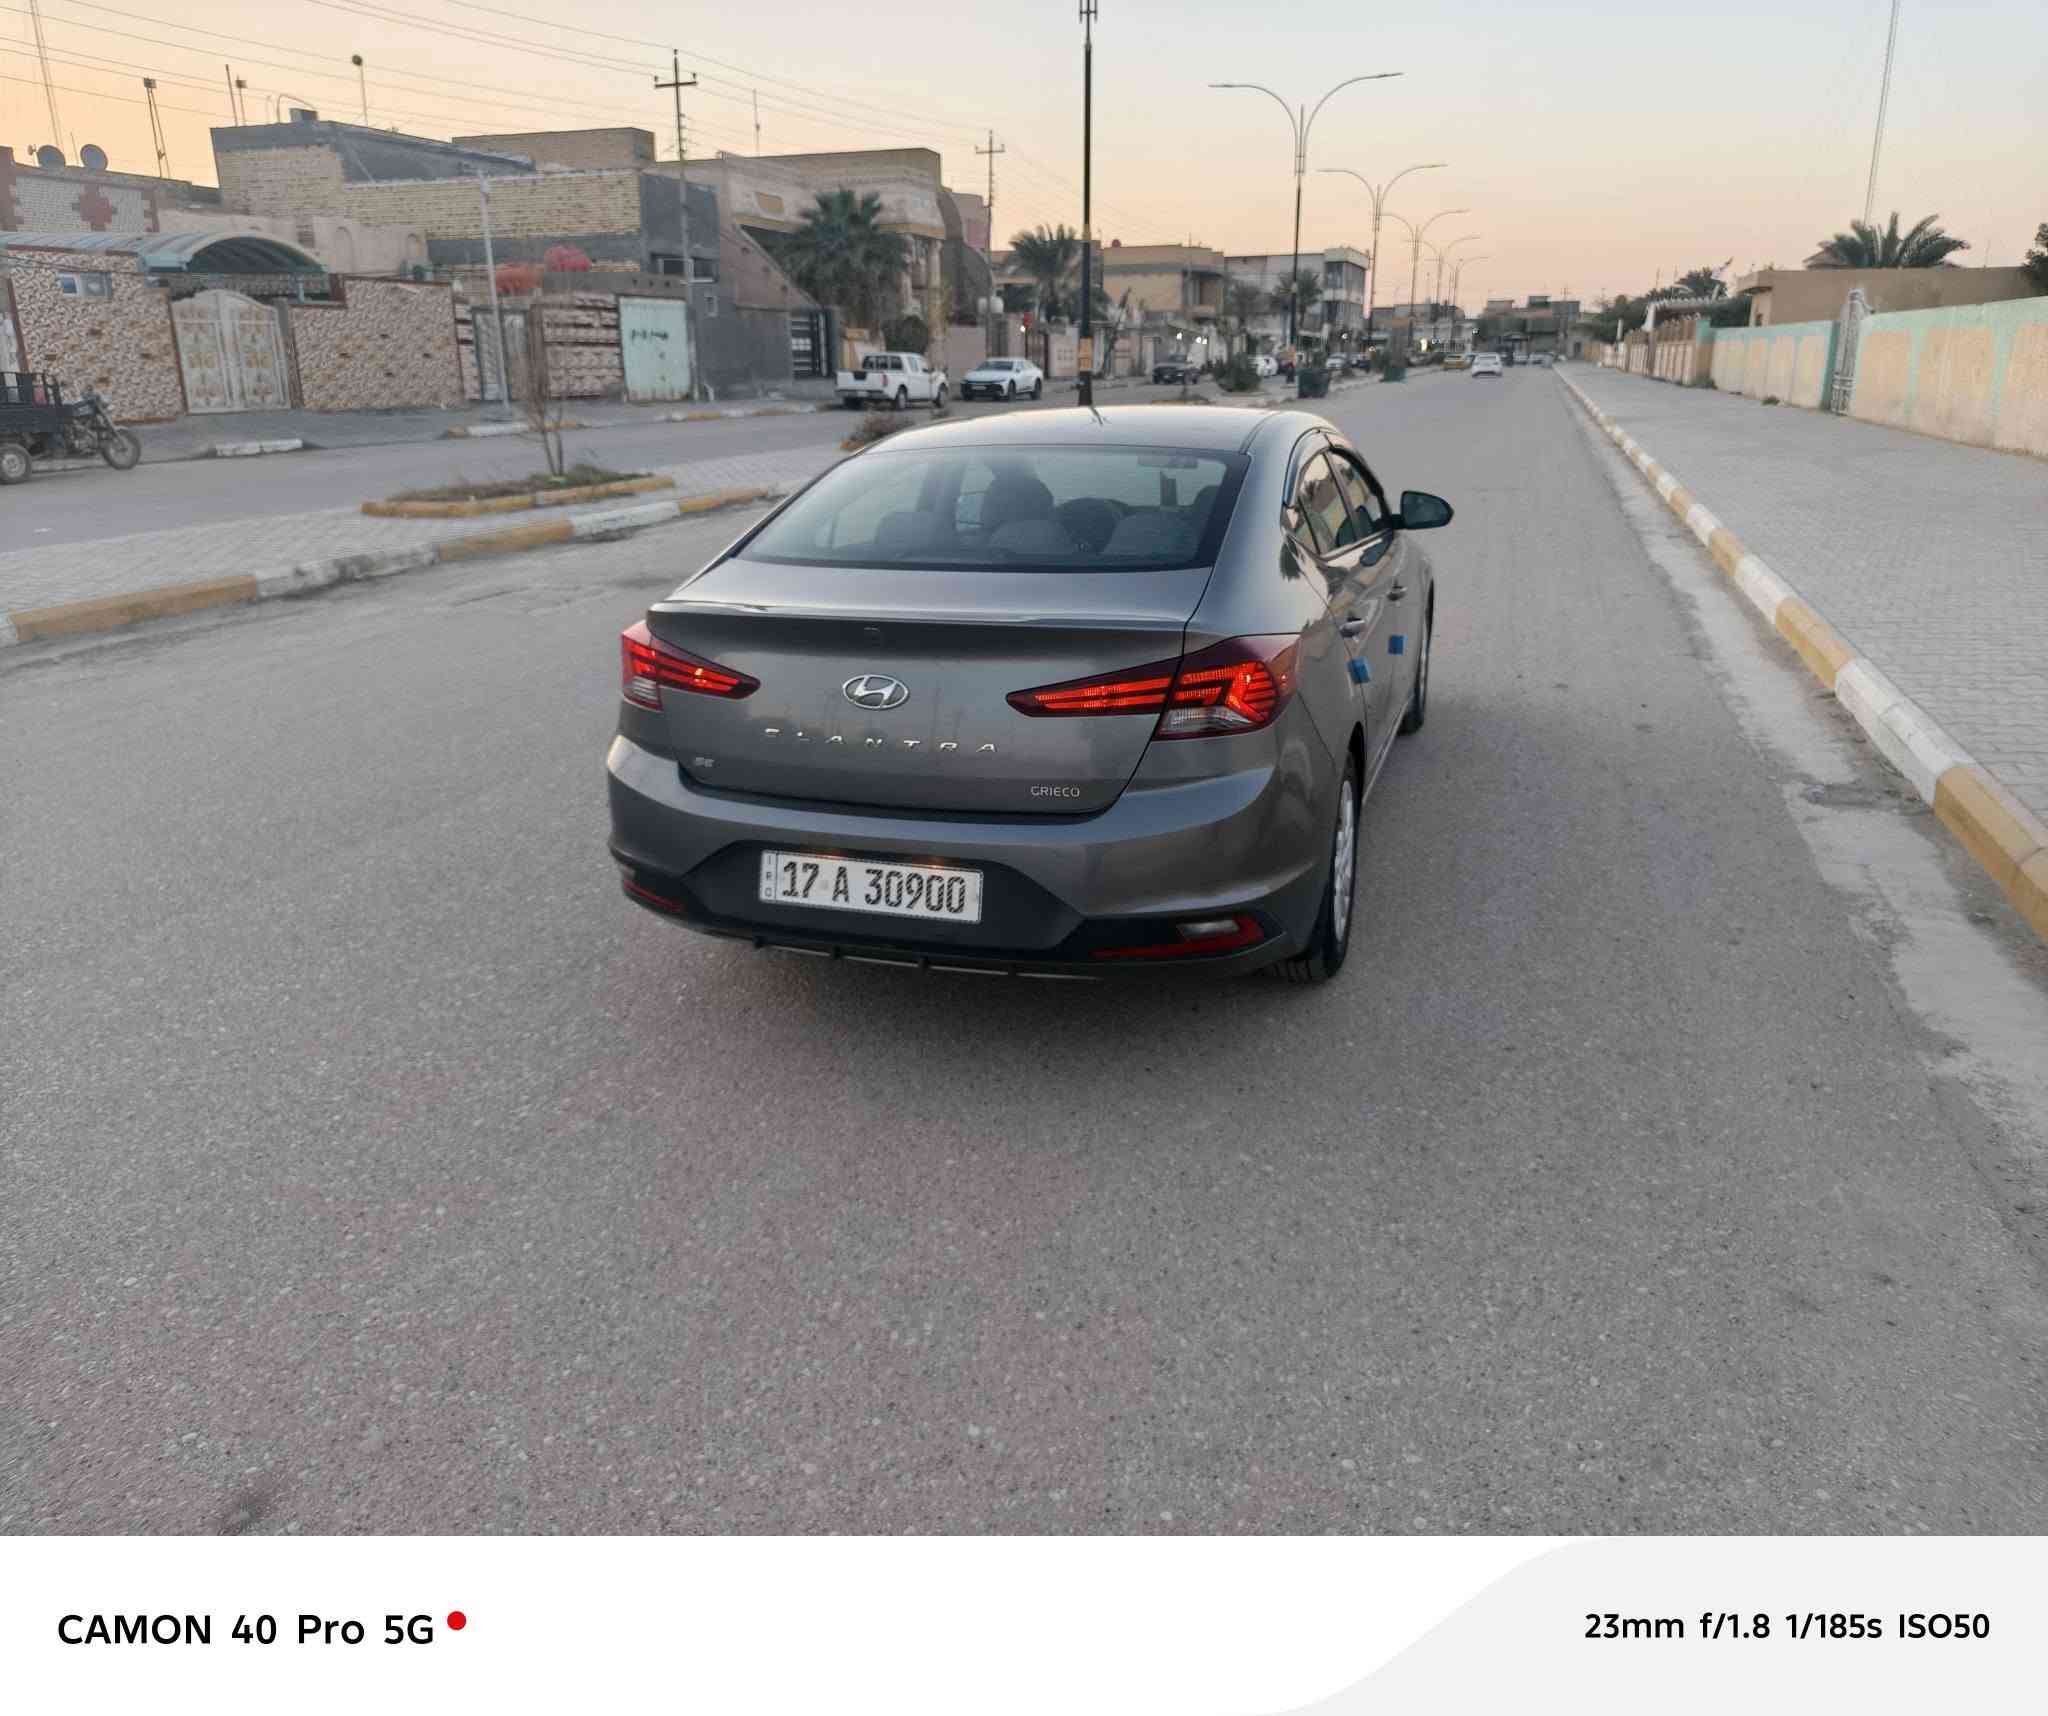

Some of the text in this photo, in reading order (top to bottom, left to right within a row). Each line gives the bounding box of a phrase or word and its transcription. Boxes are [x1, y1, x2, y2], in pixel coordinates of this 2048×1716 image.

[764, 727, 999, 753] ELANTRA
[782, 861, 966, 914] 17 A 30900
